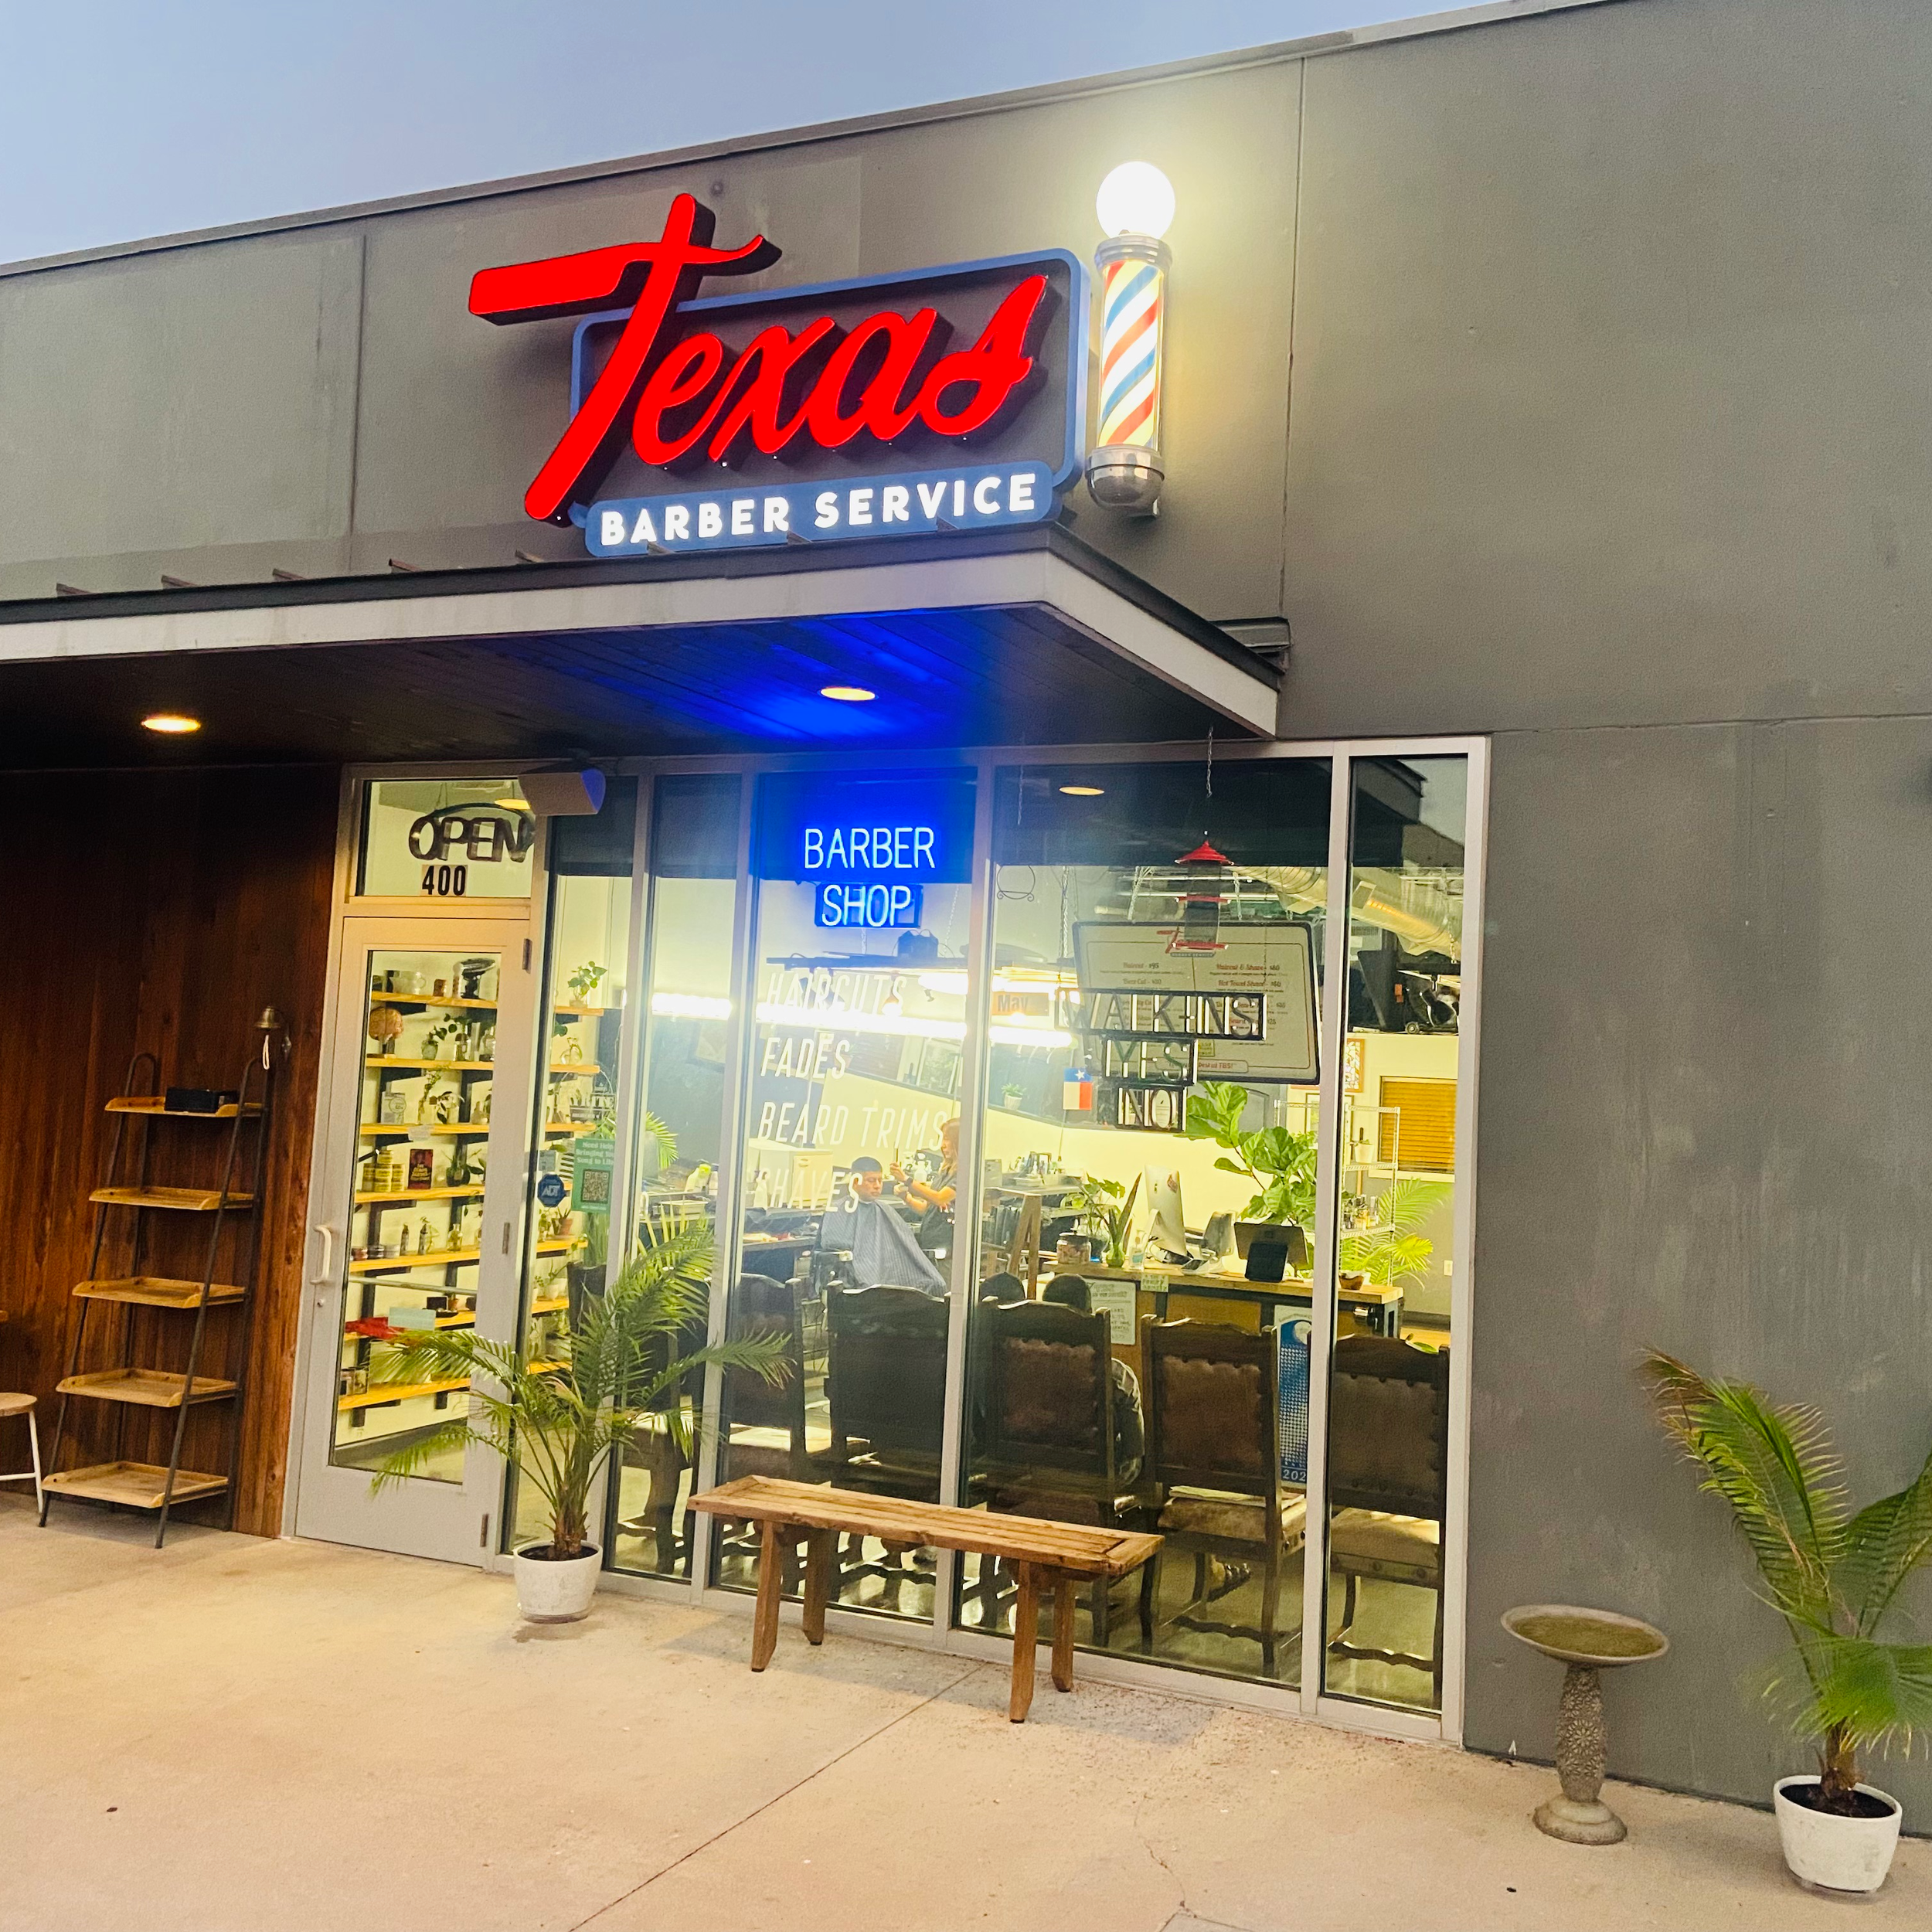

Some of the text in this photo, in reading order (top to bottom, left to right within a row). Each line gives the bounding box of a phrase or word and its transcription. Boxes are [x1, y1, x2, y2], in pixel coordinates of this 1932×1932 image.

[468, 192, 1049, 520] Texas
[600, 473, 1036, 546] BARBER SERVICE
[409, 816, 533, 863] OPEN
[804, 827, 935, 869] BARBER
[422, 865, 466, 896] 400
[821, 884, 912, 927] SHOP
[766, 972, 907, 1014] HAIRCUTS
[997, 994, 1029, 1013] May
[760, 1036, 850, 1079] FADES
[757, 1101, 948, 1151] BEARD TRIMS
[1121, 1087, 1177, 1129] NO
[542, 1185, 561, 1197] ADT
[754, 1167, 863, 1213] SHAVES
[1282, 1469, 1307, 1481] 202
